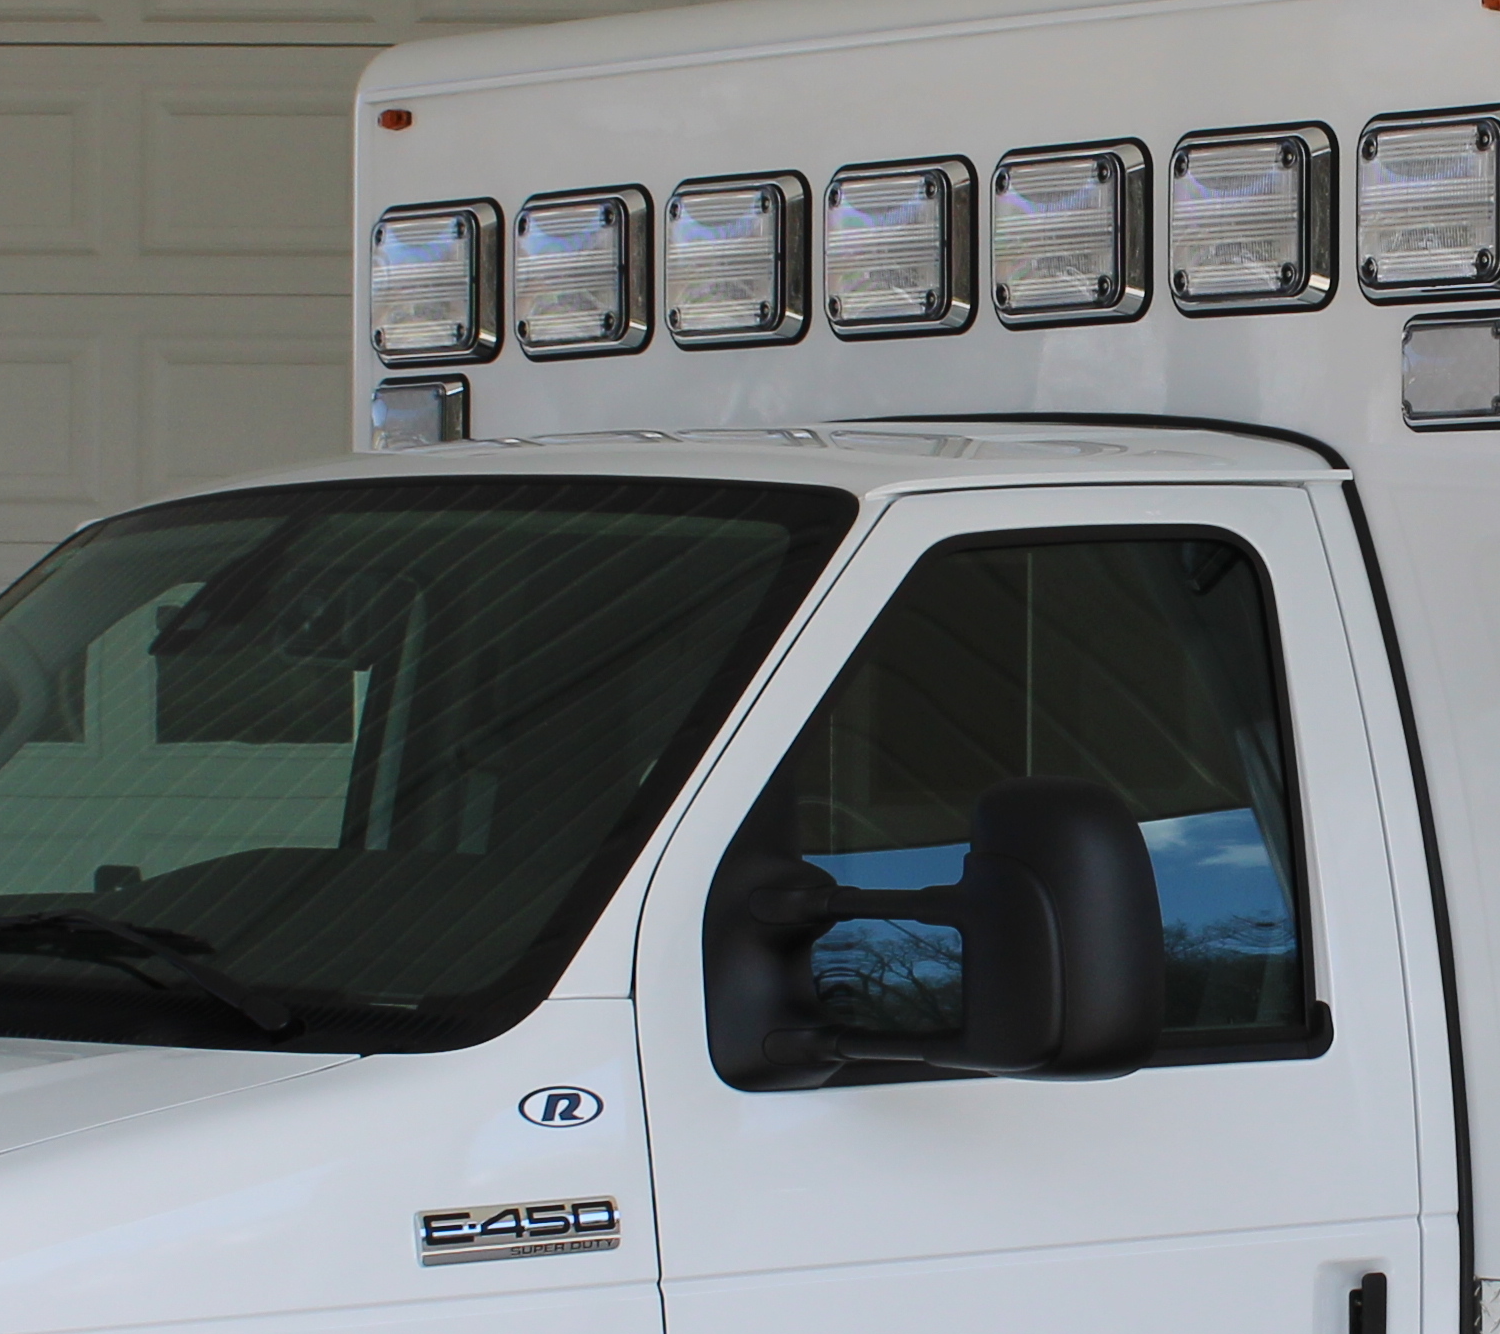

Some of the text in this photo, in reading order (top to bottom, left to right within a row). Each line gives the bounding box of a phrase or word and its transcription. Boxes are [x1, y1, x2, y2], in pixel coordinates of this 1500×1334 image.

[541, 1092, 585, 1122] R
[510, 1239, 613, 1256] SUPER DUTY
